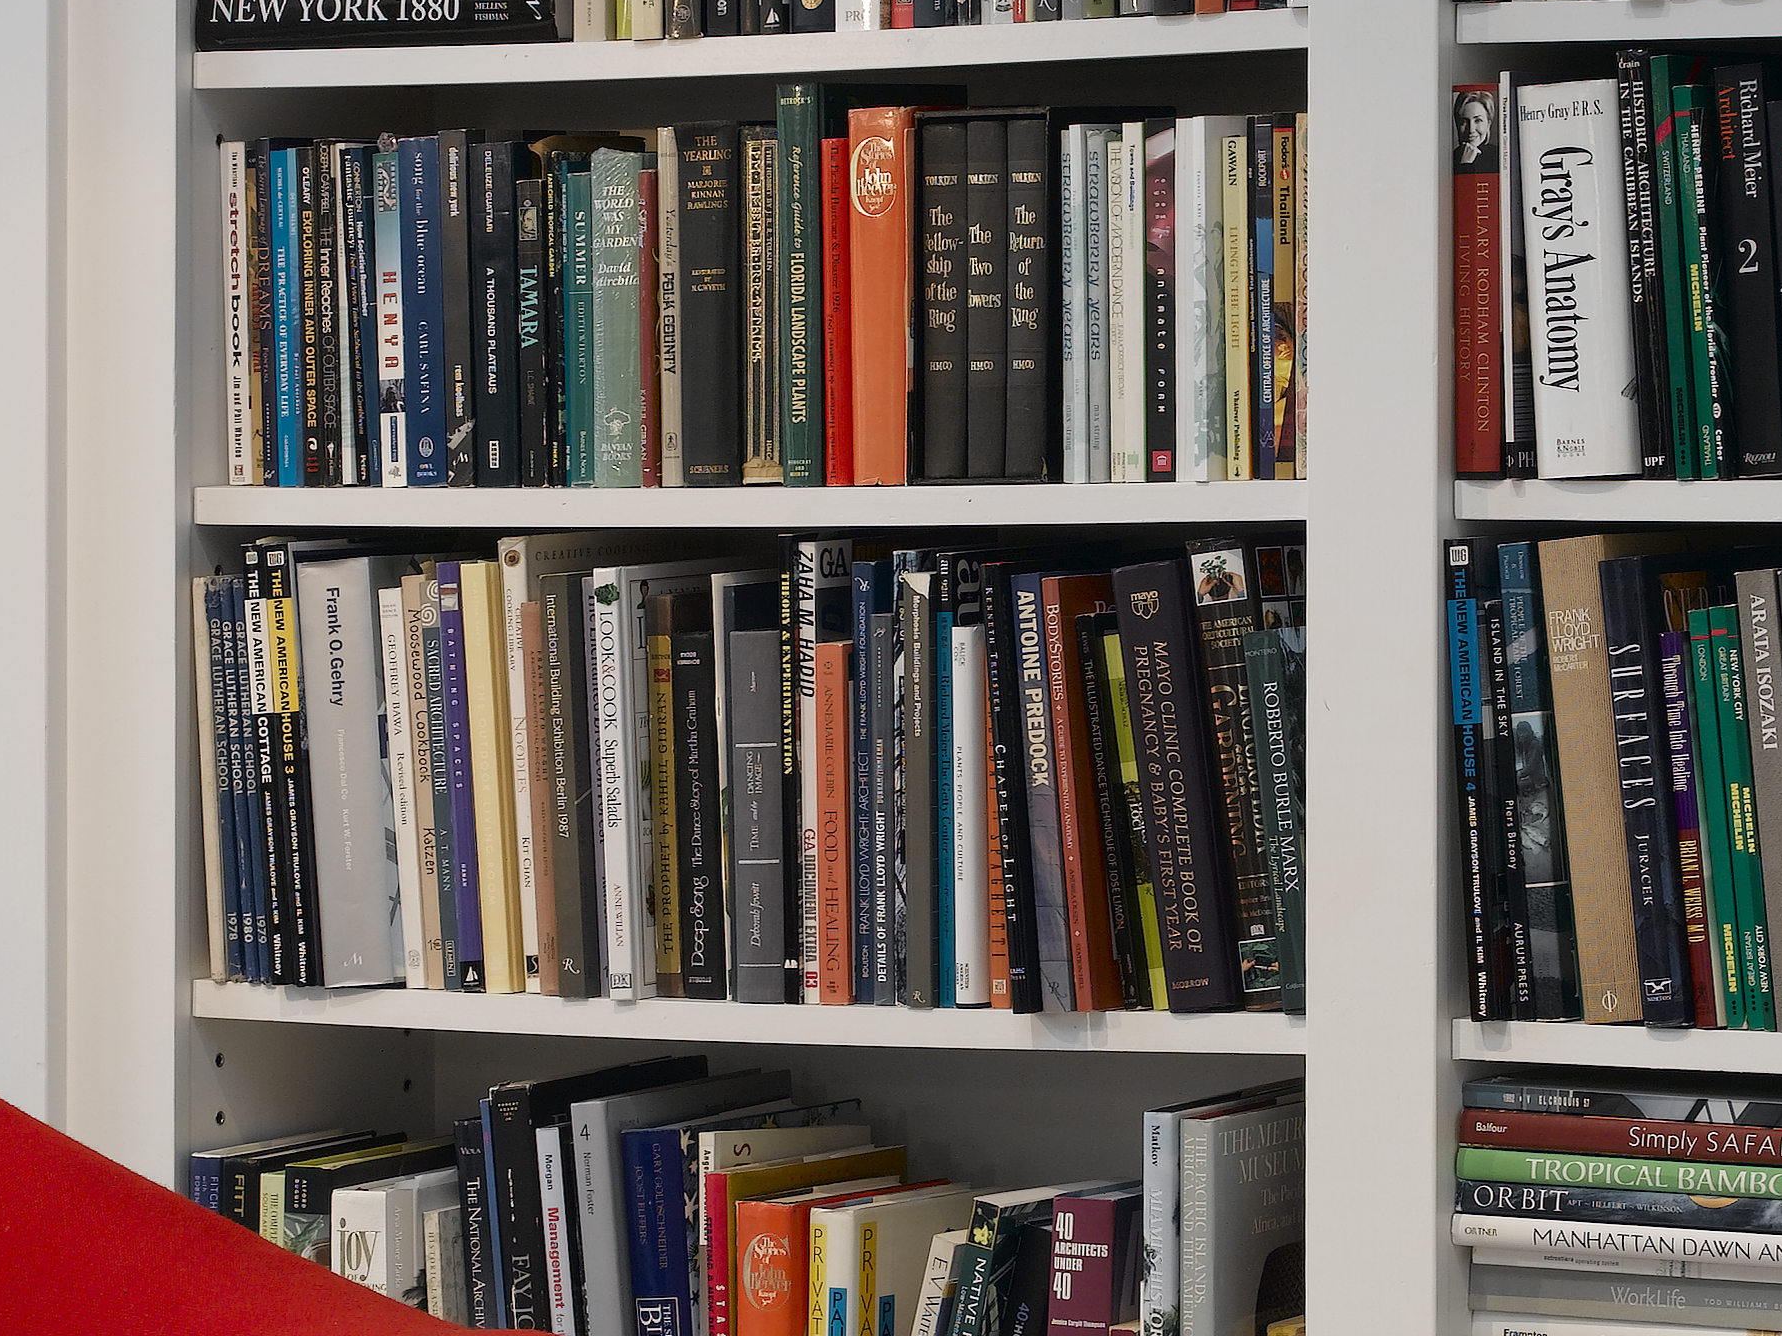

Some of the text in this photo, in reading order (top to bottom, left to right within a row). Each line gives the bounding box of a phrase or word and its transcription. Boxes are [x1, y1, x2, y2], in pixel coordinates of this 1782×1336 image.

[1531, 145, 1597, 394] Gray's Anatomy
[519, 265, 540, 350] TAMARA
[791, 253, 807, 425] FLORIDA LANDSCAPE PLANTS
[326, 587, 342, 636] Frank
[329, 657, 345, 707] Gehry
[1016, 590, 1051, 787] ANTOINE PREDOCK
[1628, 1126, 1698, 1155] Simply
[1472, 1185, 1570, 1213] ORBIT
[1526, 1157, 1669, 1189] TROPICAL
[962, 1257, 987, 1327] NATIVE
